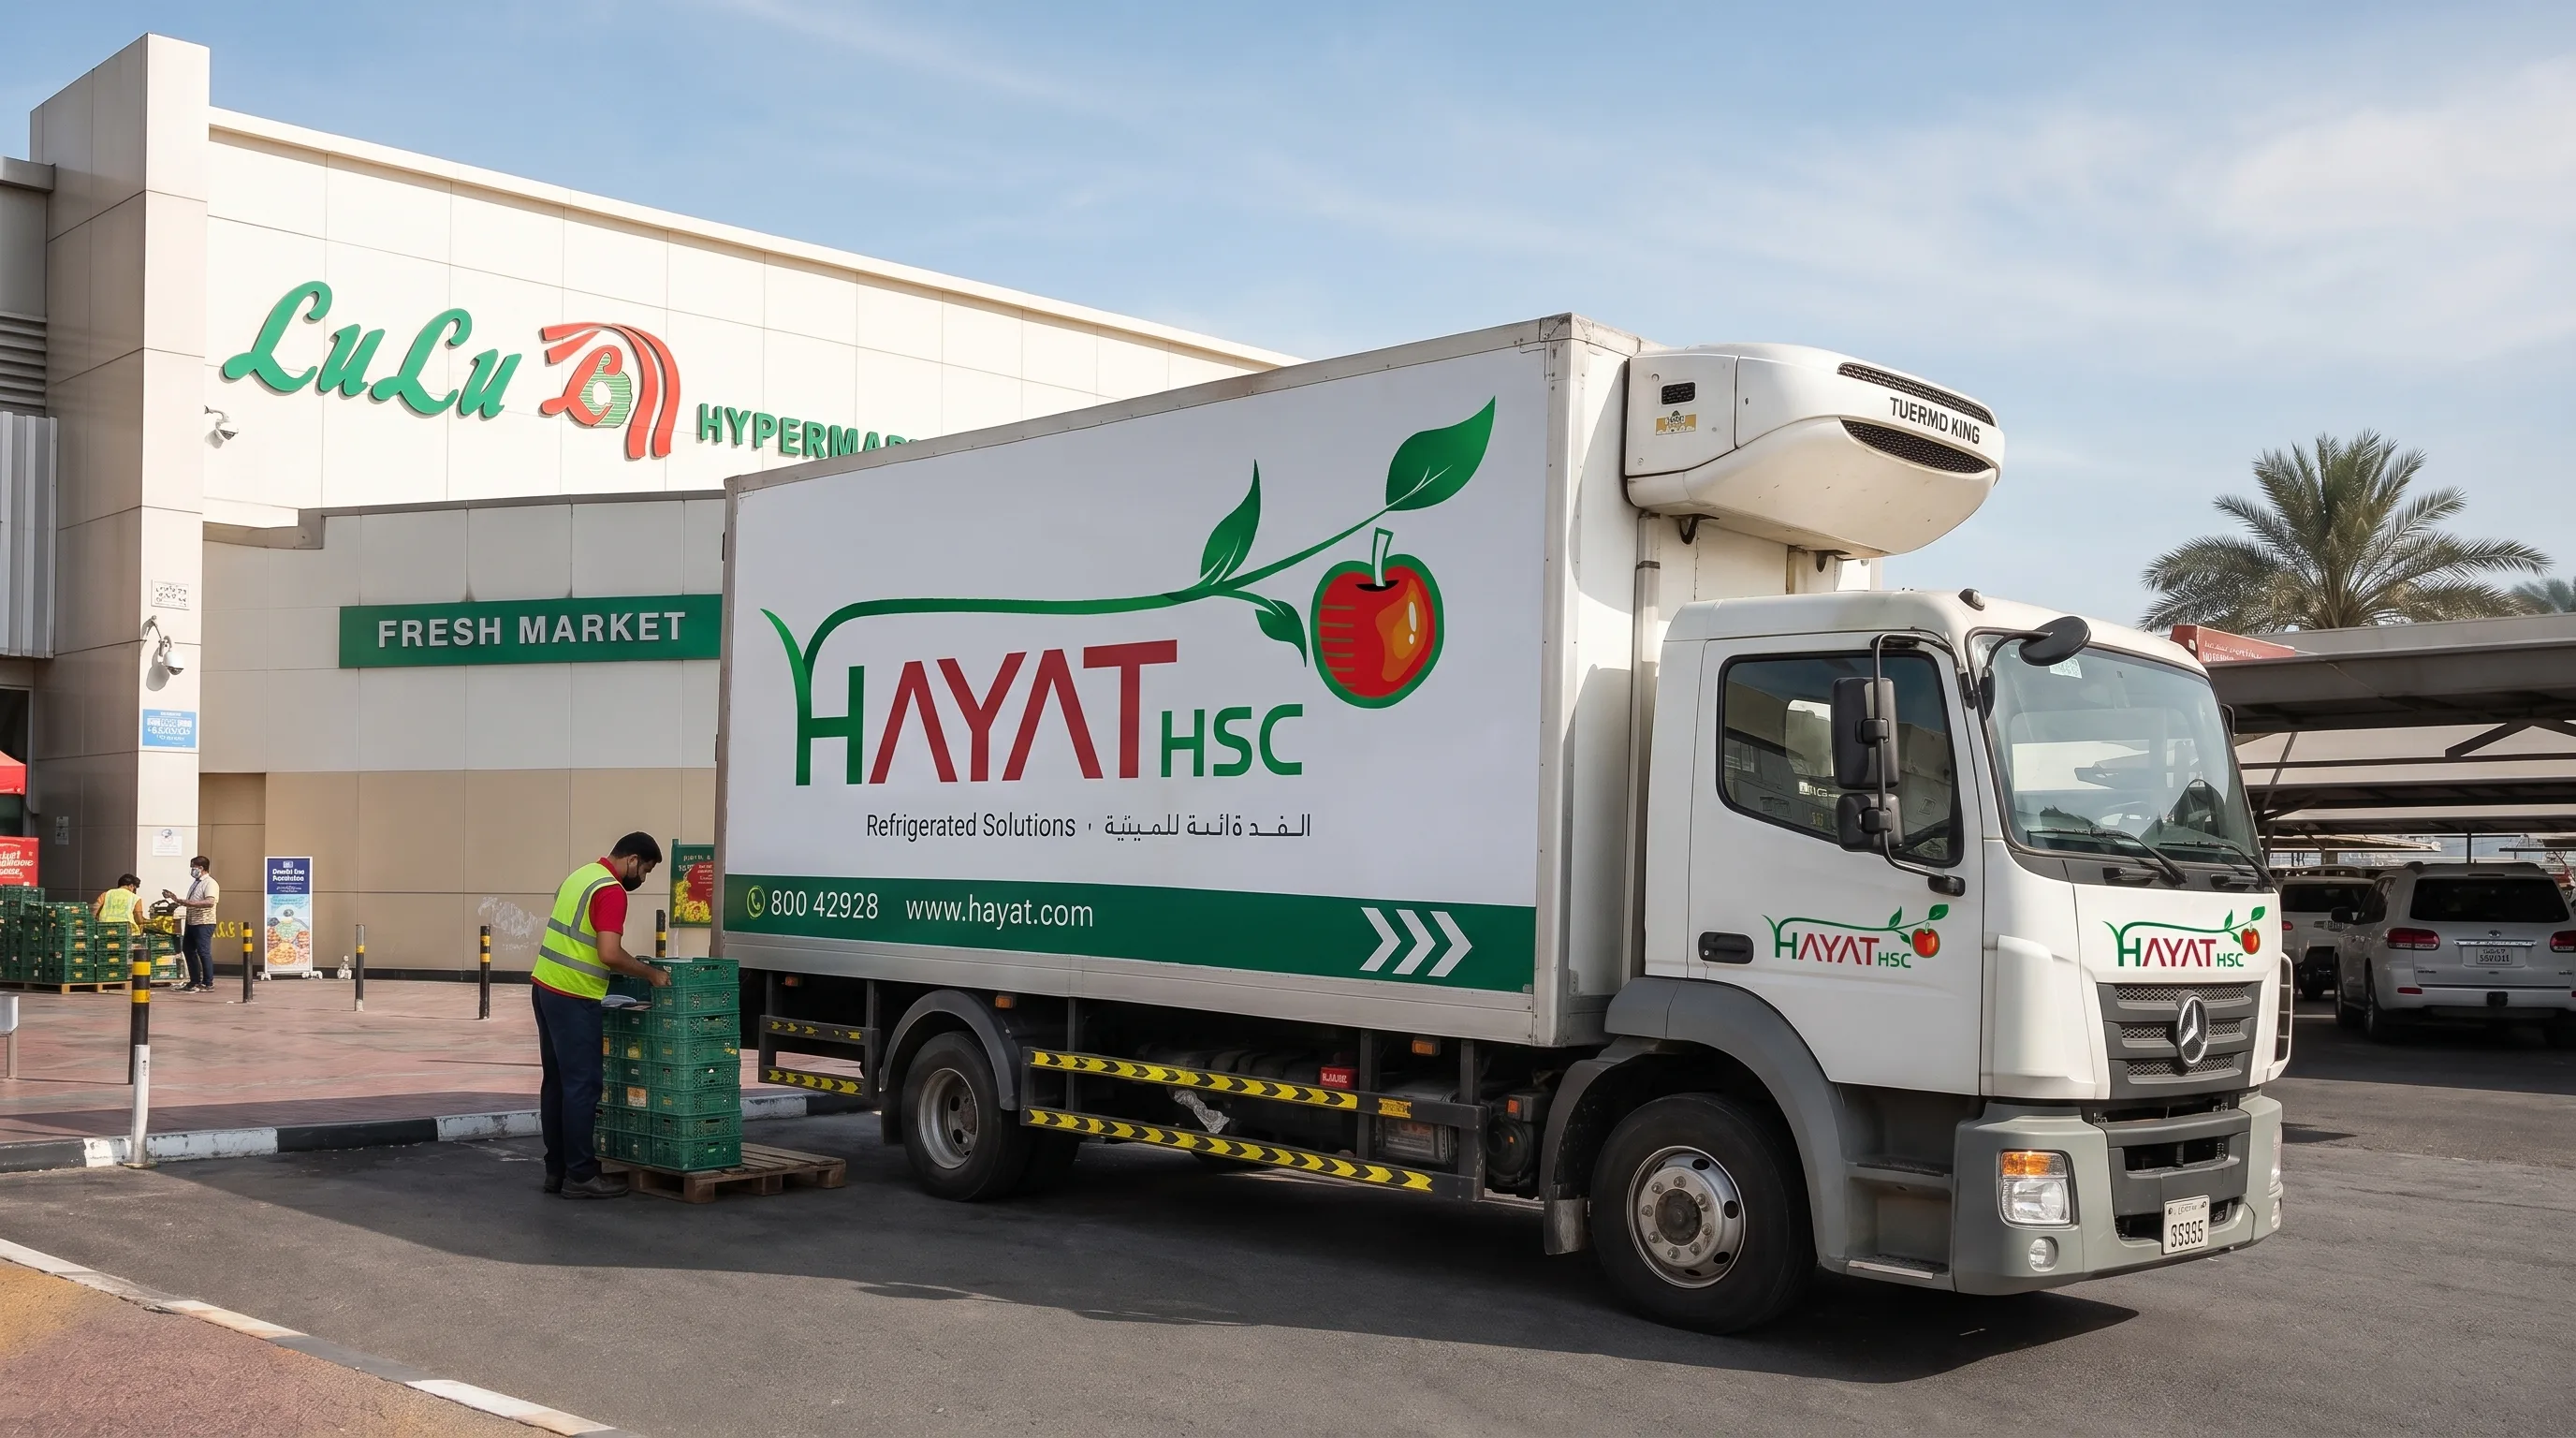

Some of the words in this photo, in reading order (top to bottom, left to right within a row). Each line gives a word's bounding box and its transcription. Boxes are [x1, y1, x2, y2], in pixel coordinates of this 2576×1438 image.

[223, 281, 523, 419] LuLu
[698, 403, 919, 459] HYPERMA
[1890, 397, 1949, 433] TUERMD
[1951, 418, 1980, 445] KING
[378, 617, 501, 648] FRESH
[519, 611, 685, 644] MARKET
[794, 639, 1178, 786] HAYAT
[1160, 703, 1305, 779] HSC
[867, 812, 977, 843] Refrigerated
[983, 812, 1076, 837] Solutions
[770, 889, 807, 917] 800
[813, 891, 878, 919] 42928
[905, 894, 1093, 931] www.hayat.com
[1775, 932, 1880, 966] HAYAT
[1878, 951, 1911, 969] HSC
[2118, 937, 2217, 967] HAYAT
[2217, 953, 2244, 967] HSC
